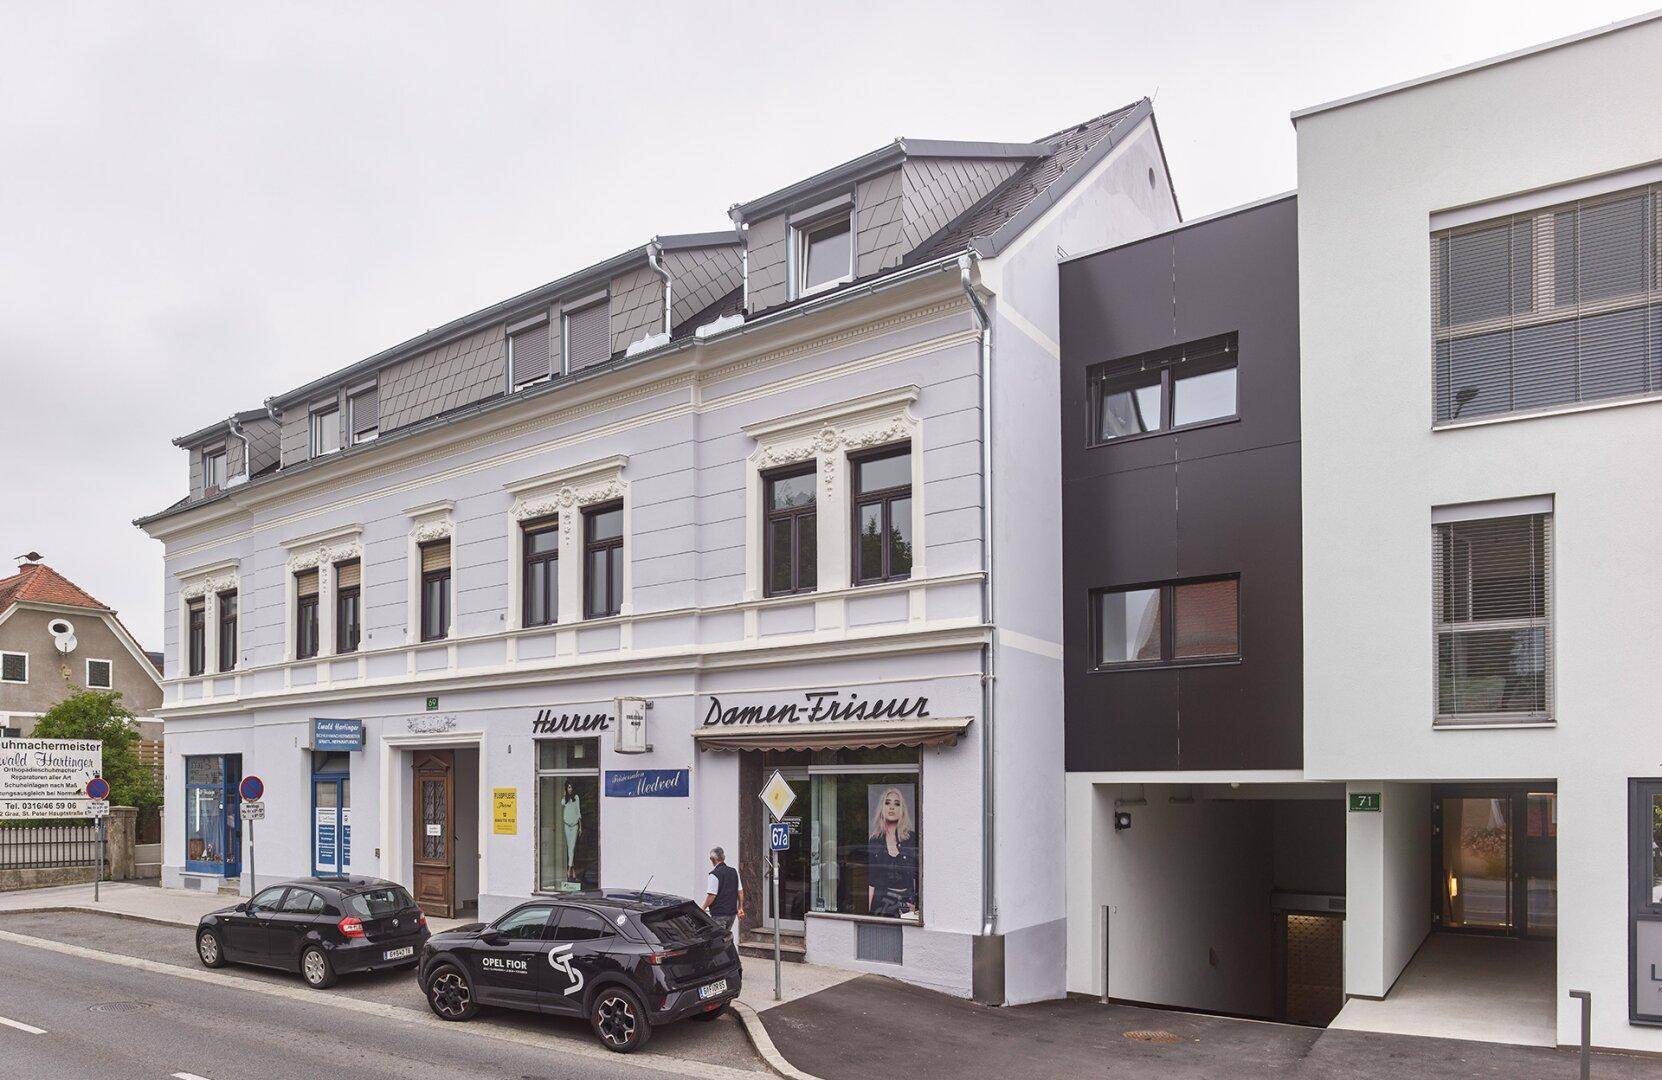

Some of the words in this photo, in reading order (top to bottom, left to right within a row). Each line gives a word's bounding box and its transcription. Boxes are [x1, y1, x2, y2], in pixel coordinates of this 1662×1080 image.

[704, 691, 930, 725] Damen-Friseur
[532, 709, 615, 734] Herren-
[34, 752, 94, 771] Hartinger
[628, 771, 681, 796] Medved
[5, 802, 20, 810] Tel.
[22, 802, 54, 810] 0316/46
[55, 802, 66, 810] 59
[67, 802, 77, 810] 06
[1358, 795, 1372, 807] 71
[772, 827, 789, 846] 67a
[482, 957, 505, 968] OPEL
[506, 959, 528, 970] FIOR
